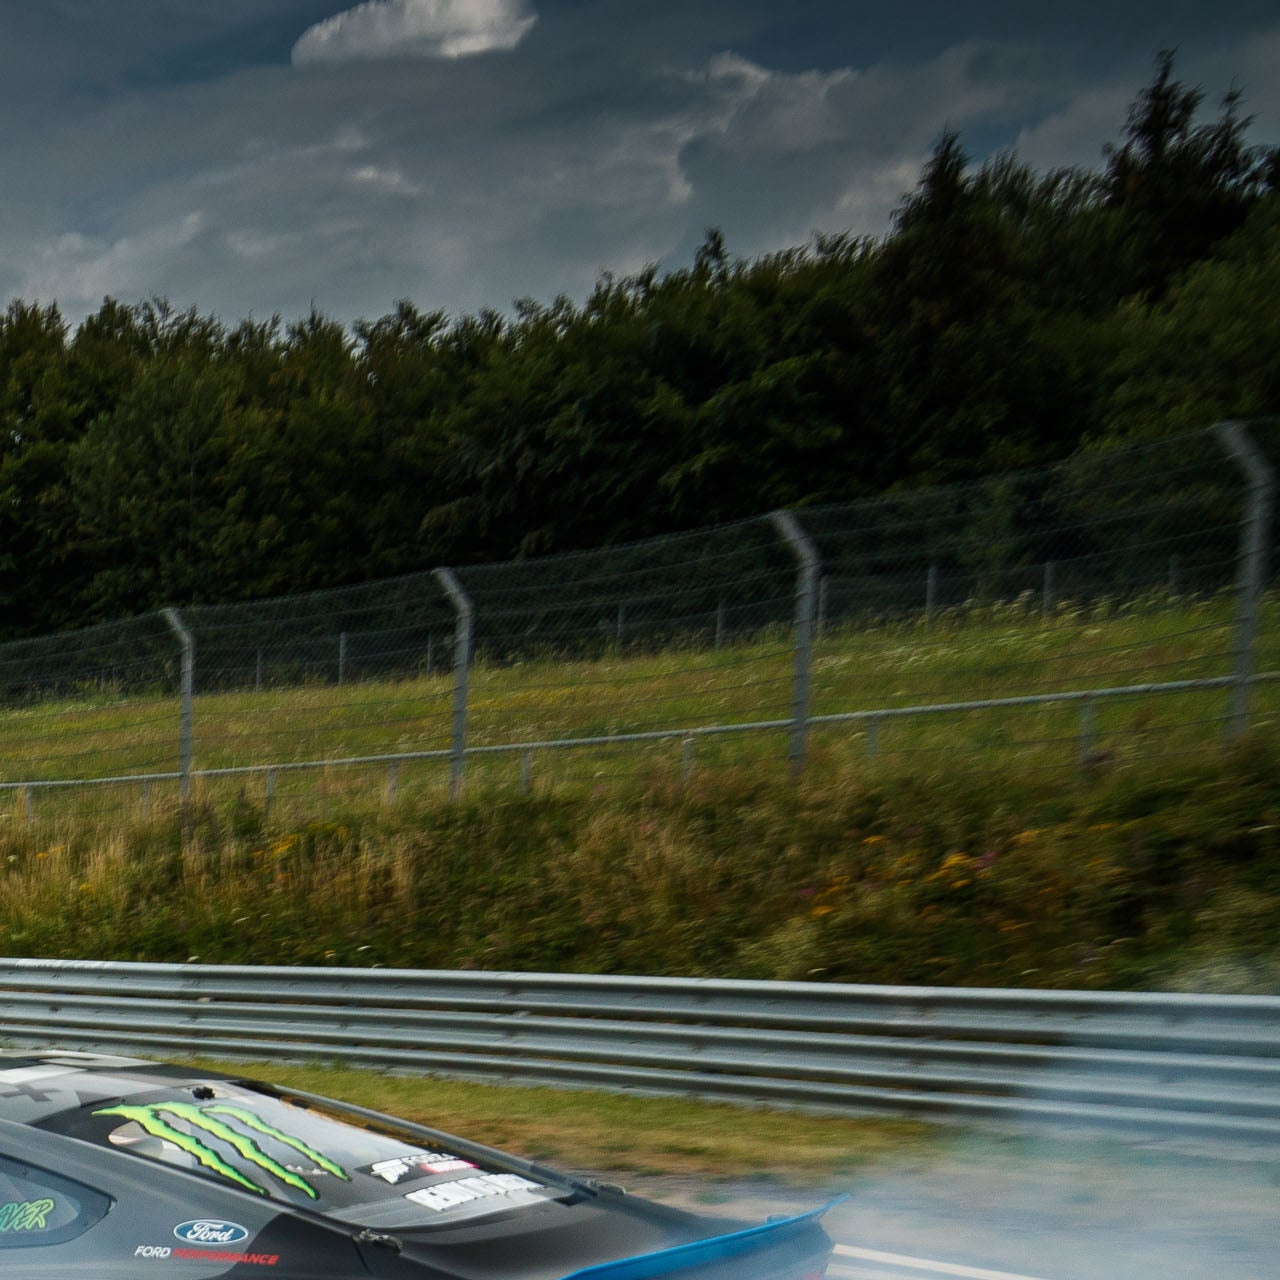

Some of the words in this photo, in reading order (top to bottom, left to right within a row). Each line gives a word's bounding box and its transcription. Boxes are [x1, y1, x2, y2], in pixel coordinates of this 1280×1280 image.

[186, 1222, 235, 1243] Ford
[134, 1245, 172, 1258] FORD
[172, 1247, 280, 1266] PERFORMANCE
